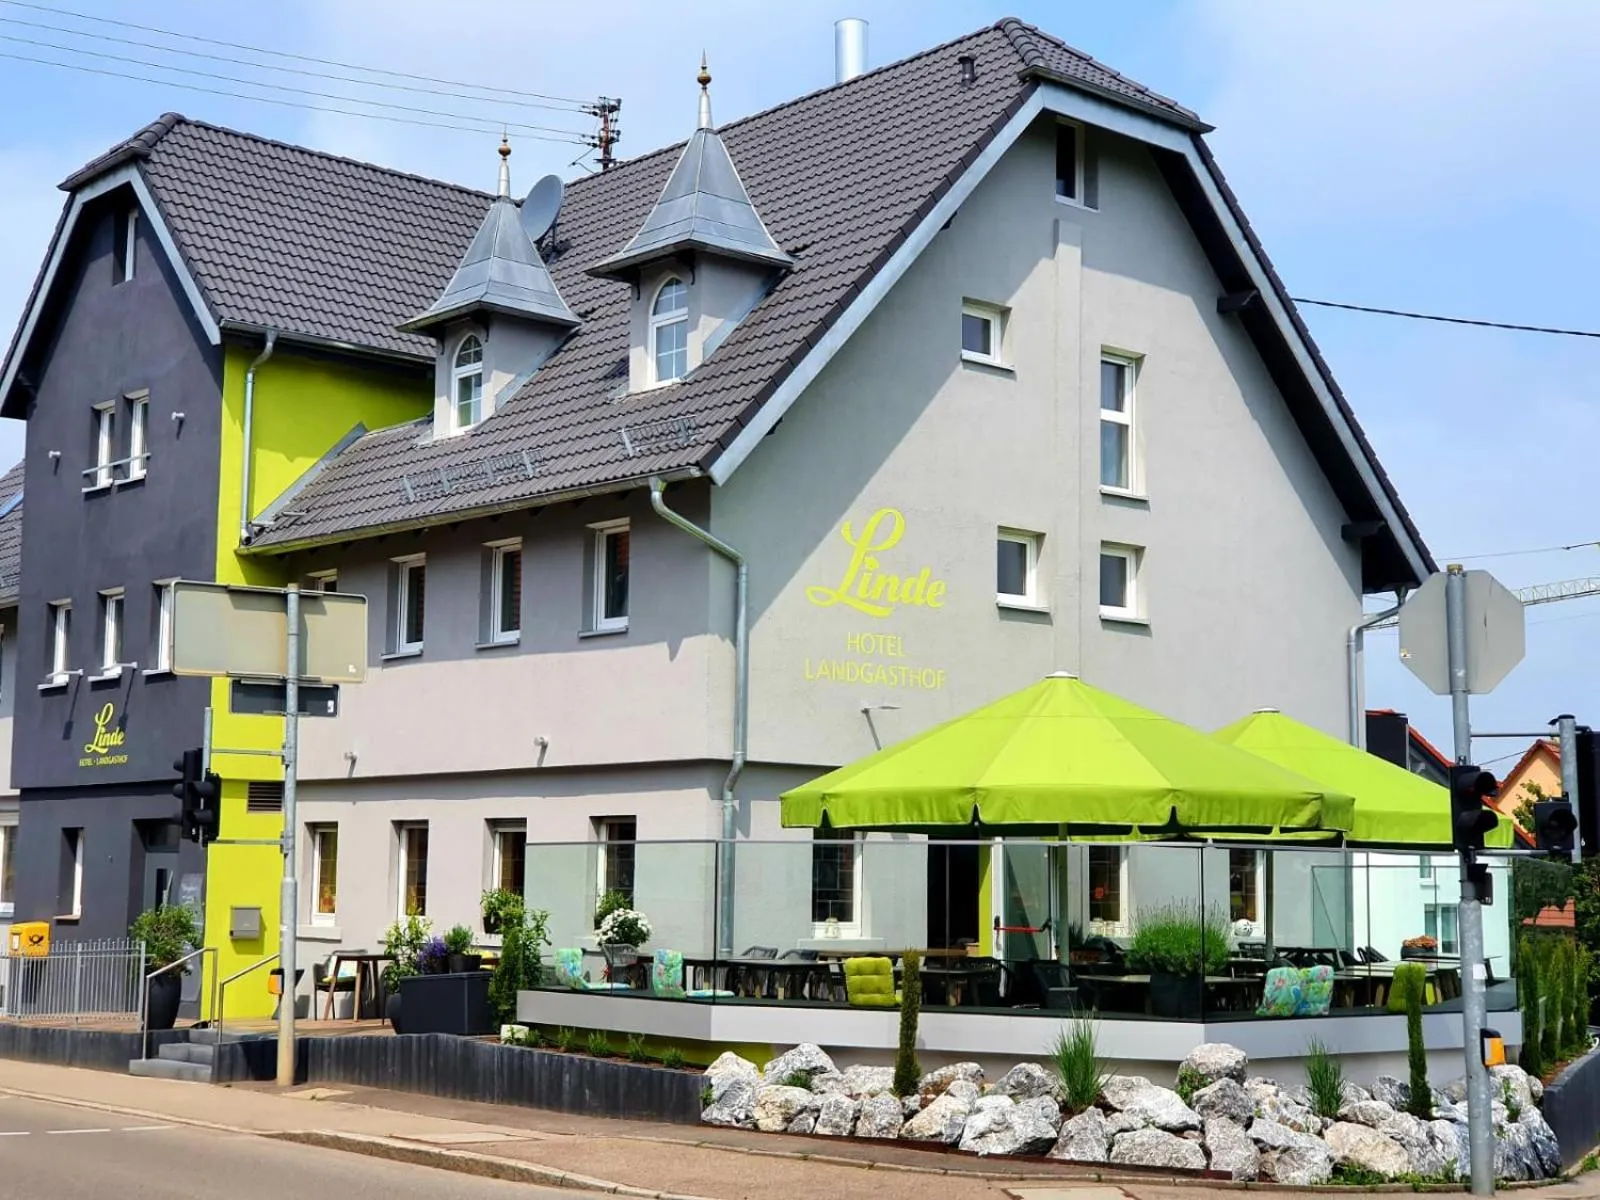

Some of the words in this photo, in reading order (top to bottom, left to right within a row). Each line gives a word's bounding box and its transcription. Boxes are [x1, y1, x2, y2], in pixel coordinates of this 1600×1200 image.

[805, 507, 947, 618] Linde
[846, 631, 906, 658] HOTEL
[804, 657, 947, 690] LANDGASTHOF
[84, 702, 125, 754] Linde
